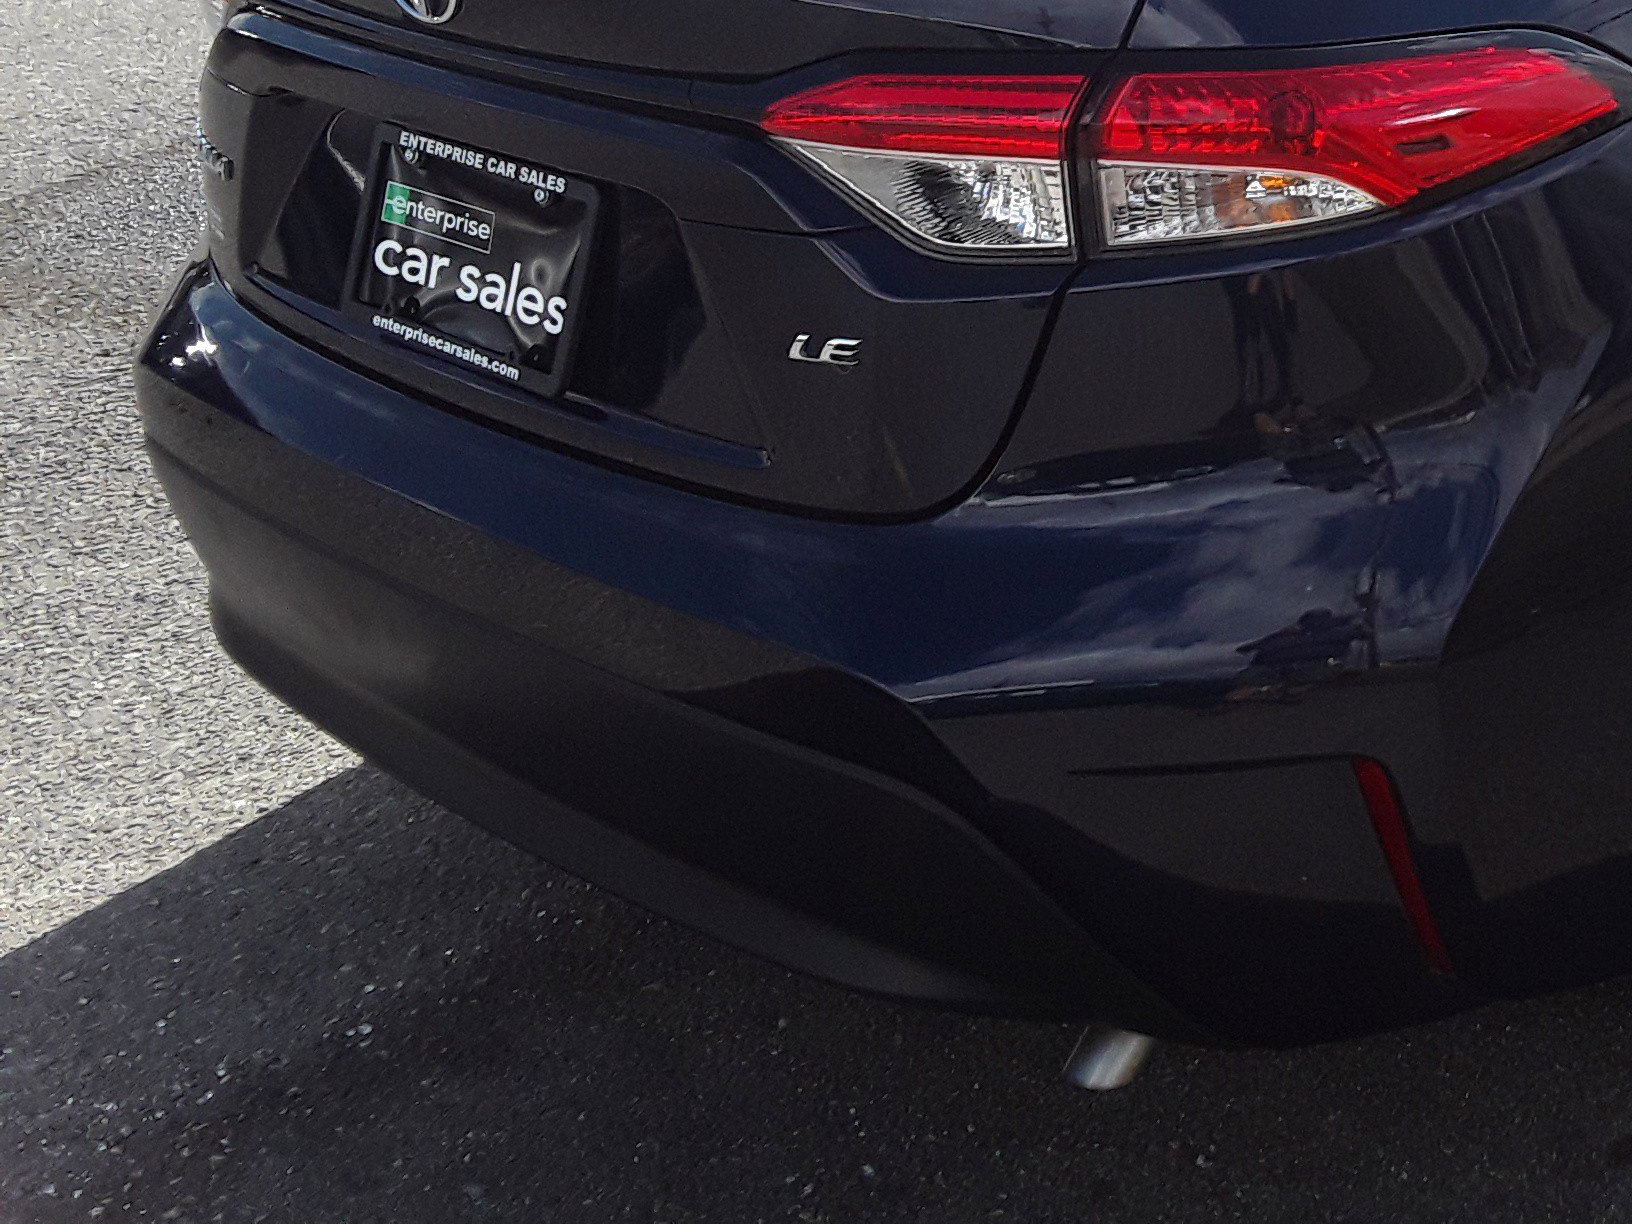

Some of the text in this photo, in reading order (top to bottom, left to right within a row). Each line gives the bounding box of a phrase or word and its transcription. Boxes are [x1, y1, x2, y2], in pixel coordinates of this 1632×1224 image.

[399, 130, 567, 194] ENTERPRISE CAR SALES
[391, 193, 492, 241] enterprise
[373, 239, 568, 336] car sales
[372, 313, 521, 382] enterprisecarsales.com
[788, 334, 863, 366] LE
